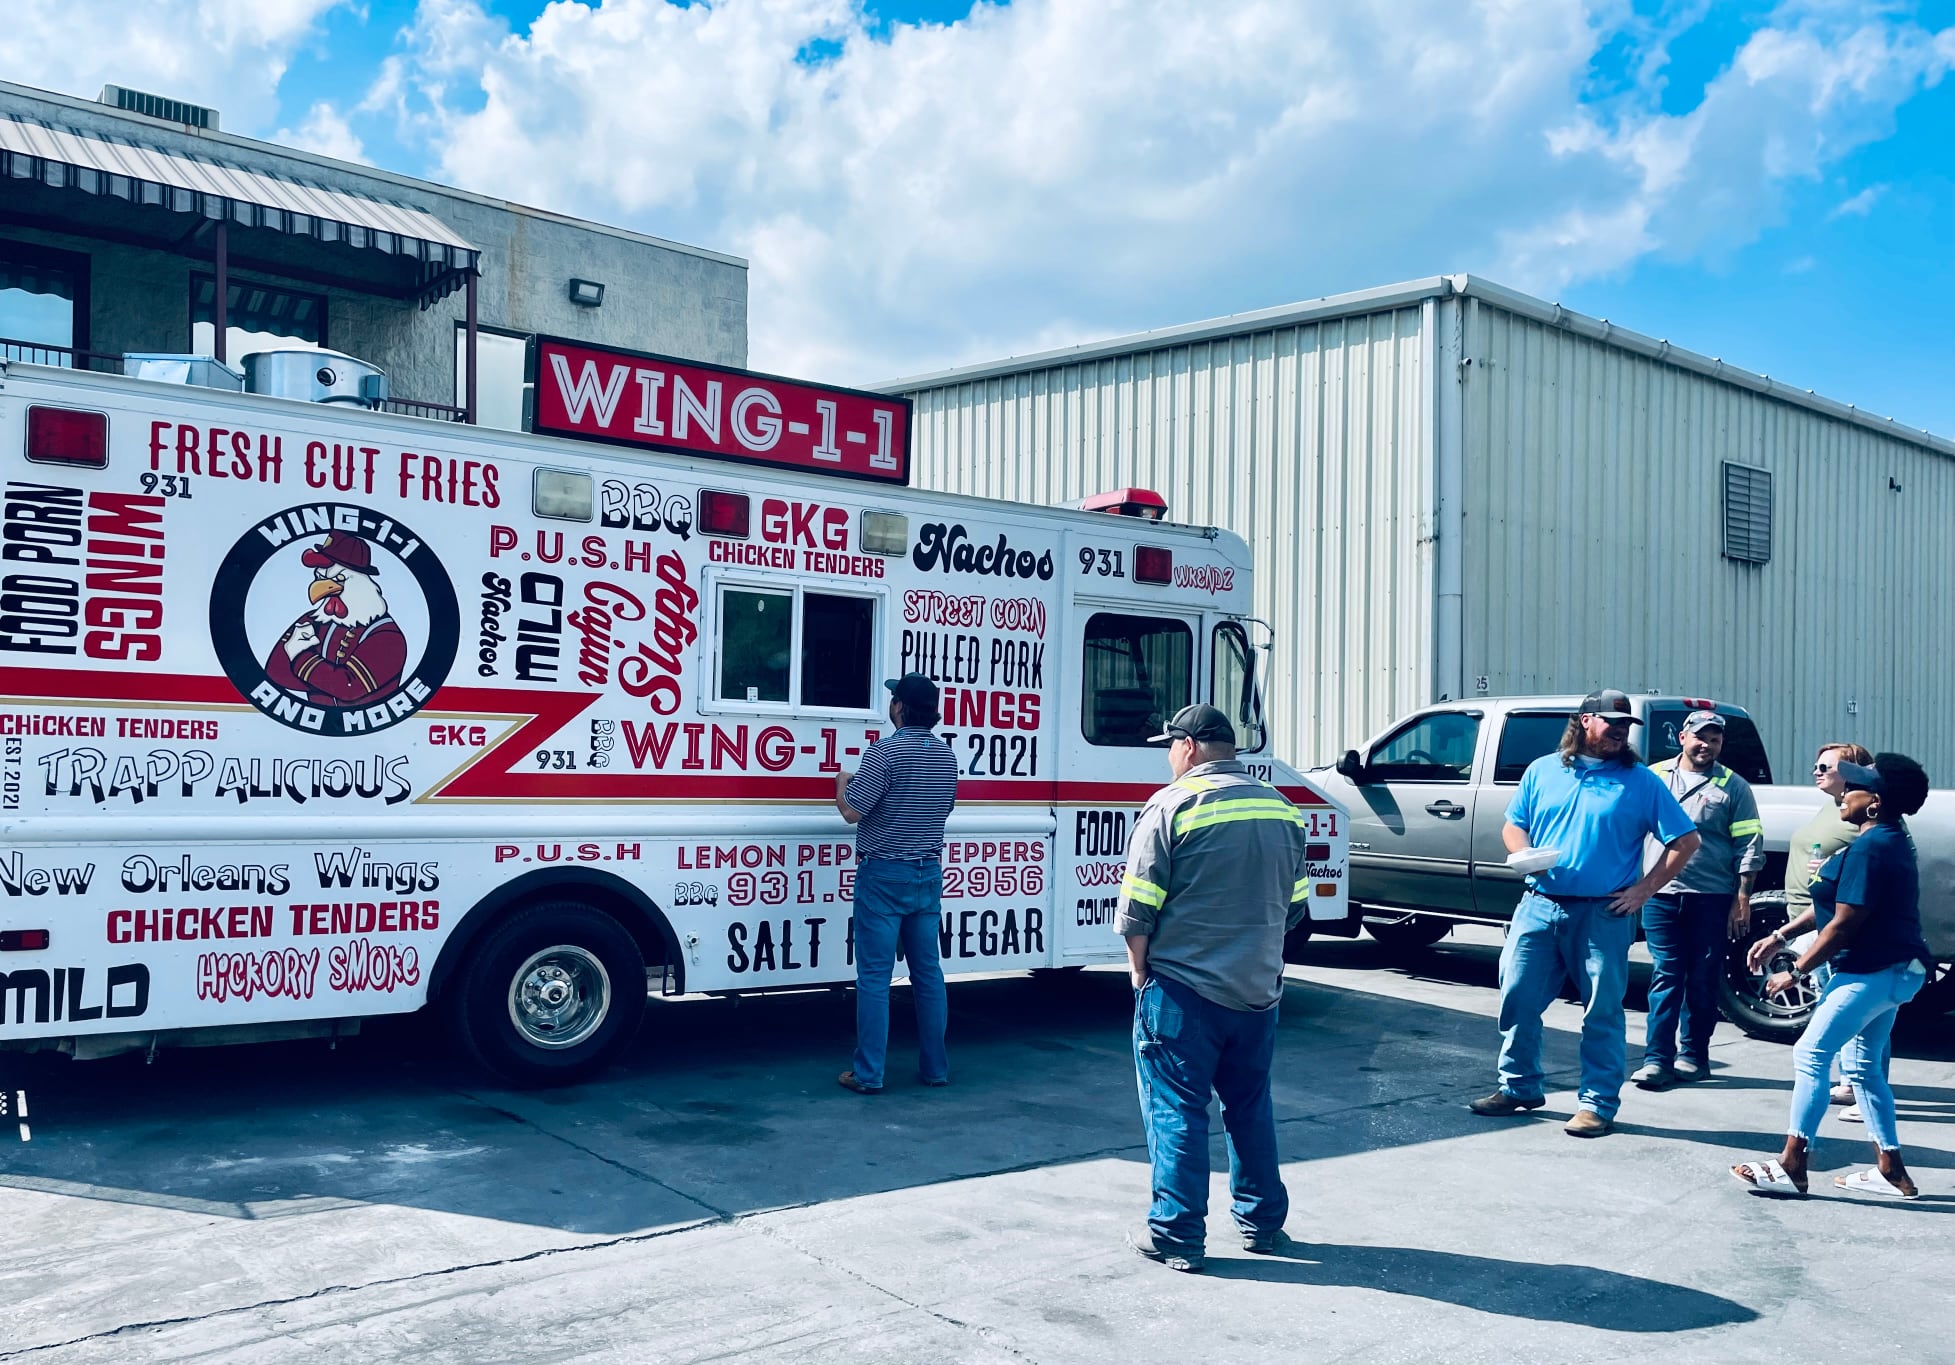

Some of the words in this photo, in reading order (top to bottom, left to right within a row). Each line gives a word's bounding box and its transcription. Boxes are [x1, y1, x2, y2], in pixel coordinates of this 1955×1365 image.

[549, 353, 897, 470] WING-1-1
[140, 473, 192, 499] 931
[149, 421, 283, 484] FRESH
[304, 441, 381, 494] CUT
[398, 452, 501, 508] FRIES
[2, 481, 83, 565] PORN
[257, 506, 420, 560] WING-1-1
[601, 480, 692, 541] BBQ
[762, 498, 849, 551] GKG
[804, 550, 885, 579] TENDERS
[913, 523, 1054, 581] Nachos
[1079, 547, 1125, 577] 931
[0, 574, 79, 655] FOOD
[478, 571, 512, 678] Nachos
[515, 572, 564, 683] MILD
[567, 581, 646, 687] Cajun
[904, 590, 986, 627] STREET
[990, 597, 1047, 640] CORN
[901, 629, 980, 684] PULLED
[990, 638, 1045, 689] PORK
[116, 718, 219, 740] TENDERS
[342, 677, 431, 732] MORE
[936, 687, 1041, 730] iNGS
[429, 725, 486, 746] GKG
[536, 750, 577, 770] 931
[587, 719, 615, 768] BBQ
[941, 733, 1037, 776] T.2021
[3, 737, 22, 809] EST.2021
[38, 747, 412, 806] TRAPPALICIOUS
[1247, 764, 1272, 782] 021
[678, 844, 786, 869] LEMON
[798, 843, 860, 867] PEP
[1075, 811, 1125, 856] FOOD
[0, 850, 96, 897] New
[121, 854, 290, 896] Orleans
[314, 847, 440, 895] Wings
[674, 882, 718, 907] BBQ
[288, 900, 440, 937] TENDERS
[1077, 896, 1120, 926] COUNT
[727, 917, 827, 973] SALT
[0, 963, 150, 1025] MILD
